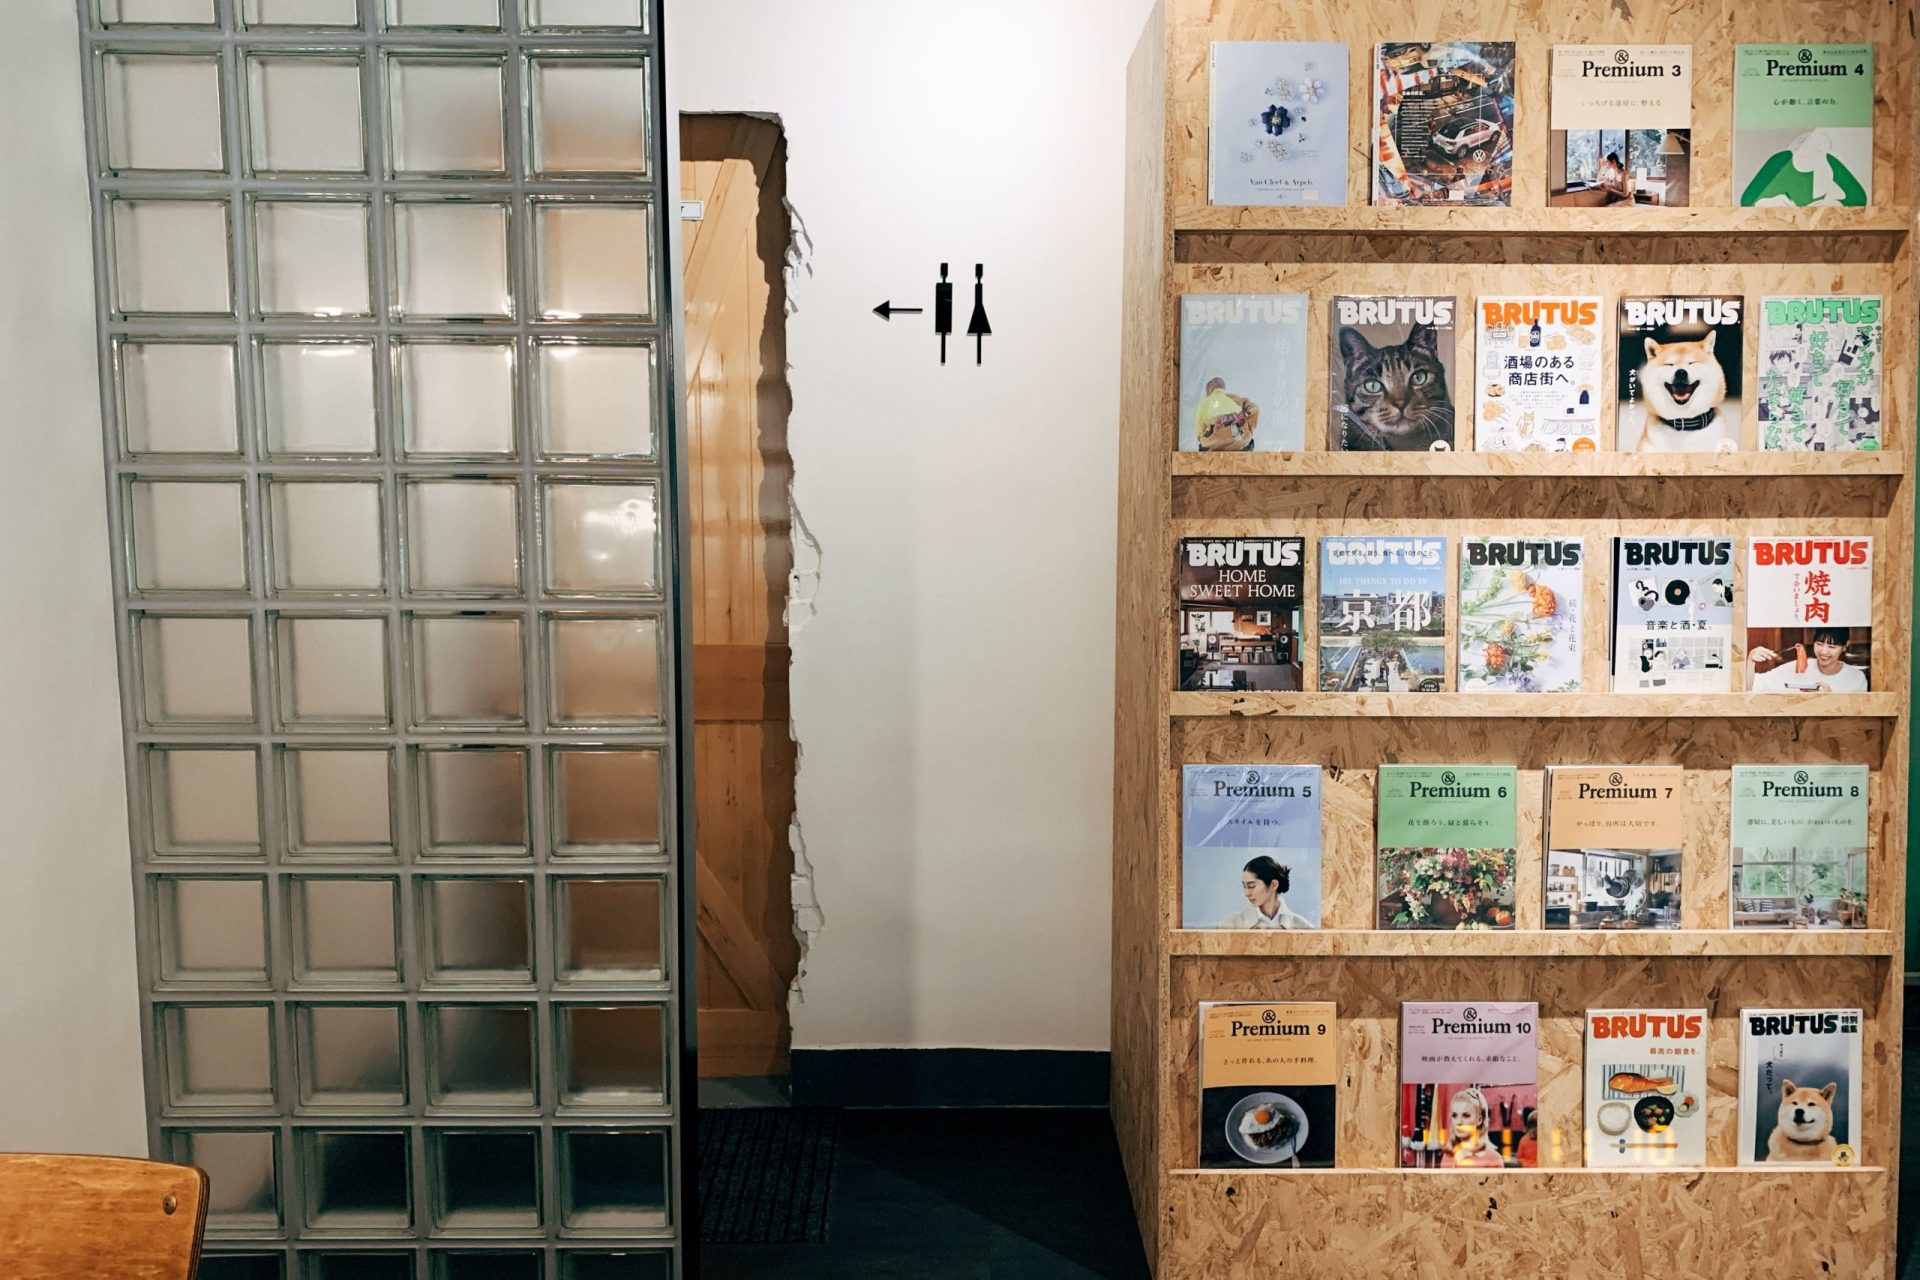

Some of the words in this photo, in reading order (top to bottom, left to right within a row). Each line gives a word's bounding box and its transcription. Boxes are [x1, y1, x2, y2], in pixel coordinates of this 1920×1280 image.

[1582, 60, 1664, 77] Premium
[1672, 65, 1681, 76] 3
[1766, 59, 1847, 76] Premium
[1854, 64, 1864, 76] 4
[1185, 299, 1300, 325] BRUTUS
[1337, 299, 1453, 325] BRUTUS
[1482, 300, 1598, 326] BRUTUS
[1624, 299, 1740, 326] BRUTUS
[1765, 298, 1881, 325] BRUTUS
[1504, 355, 1574, 370] 酒場のある
[1508, 372, 1575, 386] 商店街へ。
[1186, 540, 1300, 567] BRUTUS
[1326, 539, 1442, 565] BRUTUS
[1467, 540, 1581, 566] BRUTUS
[1624, 540, 1731, 566] BRUTUS
[1753, 540, 1869, 566] BRUTUS
[1219, 569, 1266, 582] HOME
[1189, 584, 1242, 598] SWEET
[1248, 584, 1295, 597] HOME
[1804, 570, 1831, 624] 焼肉
[1335, 589, 1432, 633] 京都
[1214, 780, 1294, 797] Premium
[1302, 786, 1311, 797] 5
[1410, 781, 1490, 798] Premium
[1498, 787, 1507, 798] 6
[1579, 783, 1657, 799] Premium
[1665, 788, 1673, 798] 7
[1762, 781, 1843, 797] Premium
[1850, 786, 1859, 797] 8
[1232, 1020, 1310, 1036] Premium
[1317, 1024, 1326, 1035] 9
[1432, 1018, 1511, 1034] Premium
[1516, 1022, 1531, 1034] 10
[1591, 1013, 1702, 1039] BRUTUS
[1749, 1013, 1839, 1036] BRUTUS
